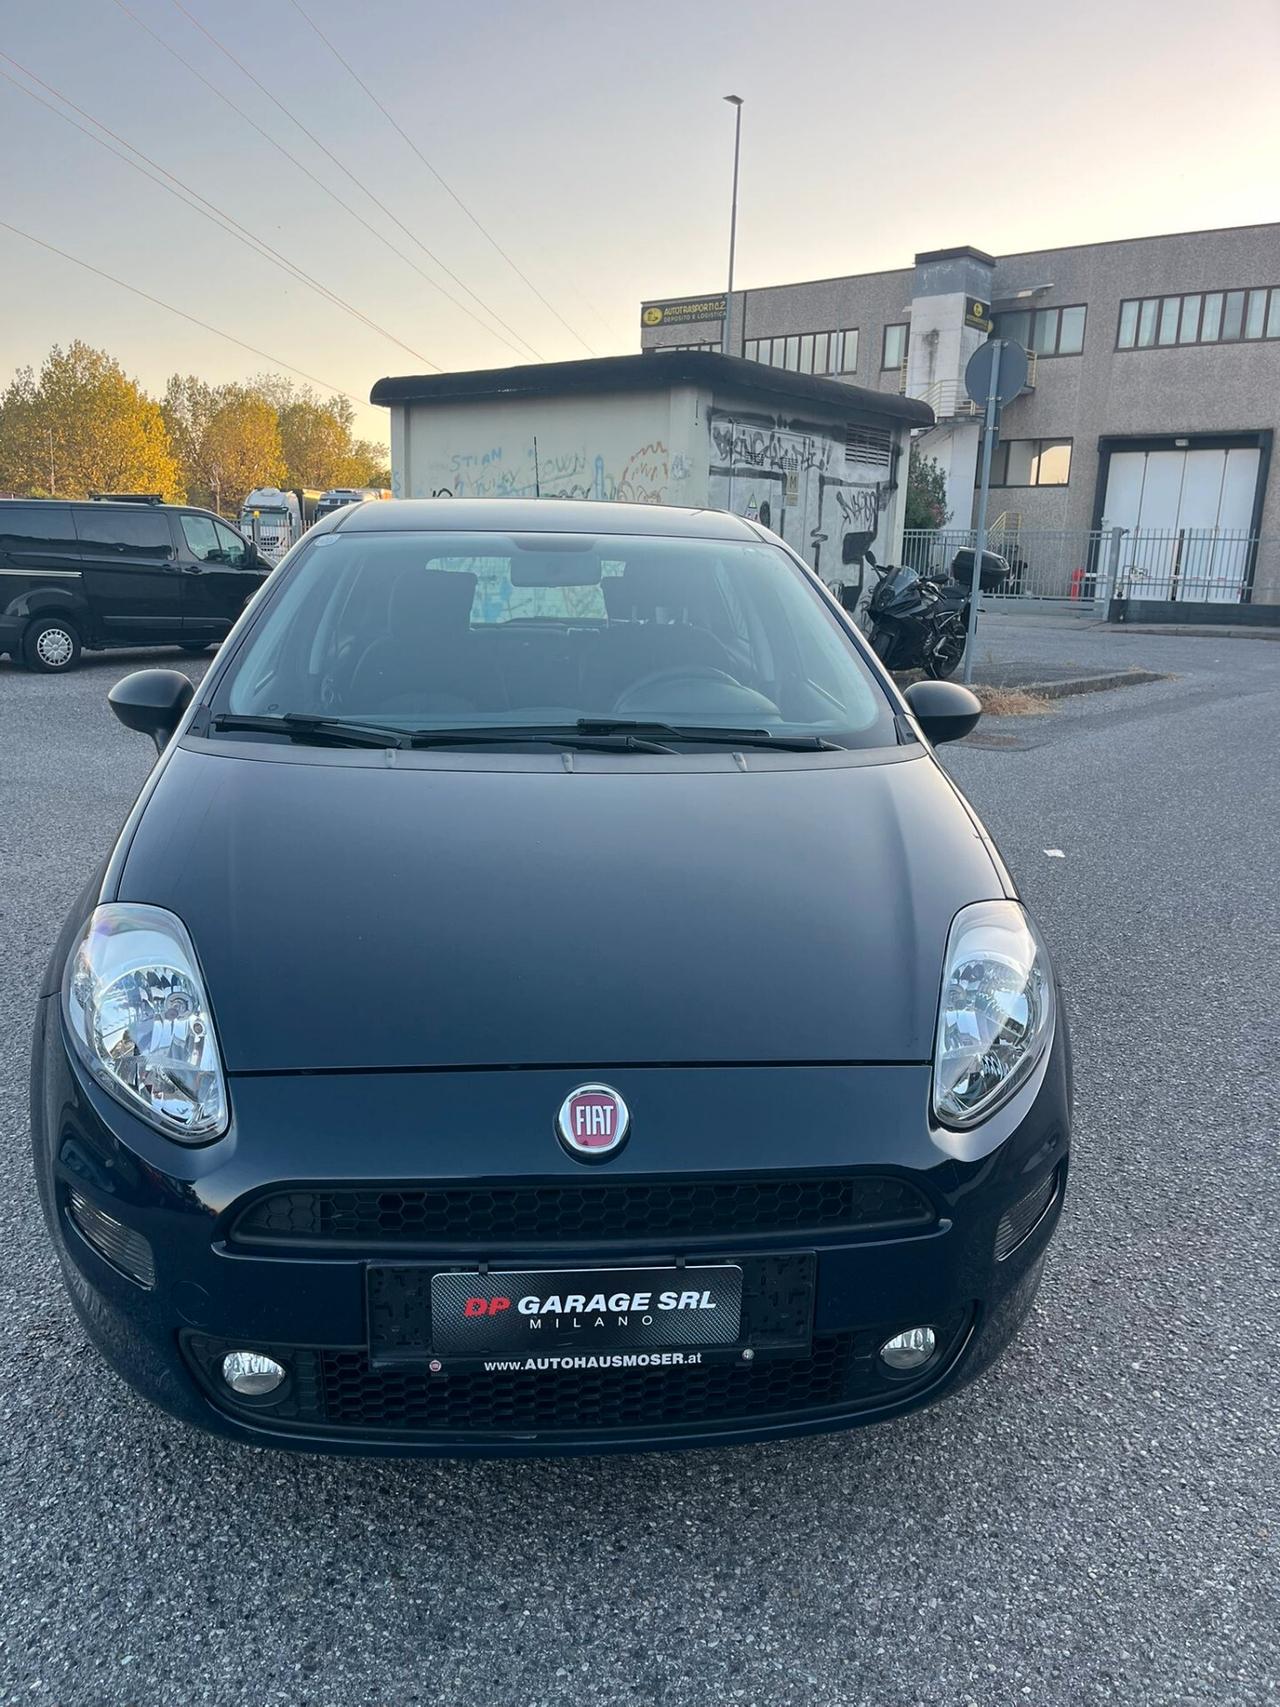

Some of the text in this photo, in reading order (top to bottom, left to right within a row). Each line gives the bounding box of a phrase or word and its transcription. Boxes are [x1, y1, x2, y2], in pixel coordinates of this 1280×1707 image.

[575, 1104, 615, 1136] FIAT
[464, 1290, 717, 1317] DP GARAGE SRL
[529, 1315, 653, 1330] MILANO
[484, 1352, 702, 1372] www.AUTOHAUSMOSER.at
